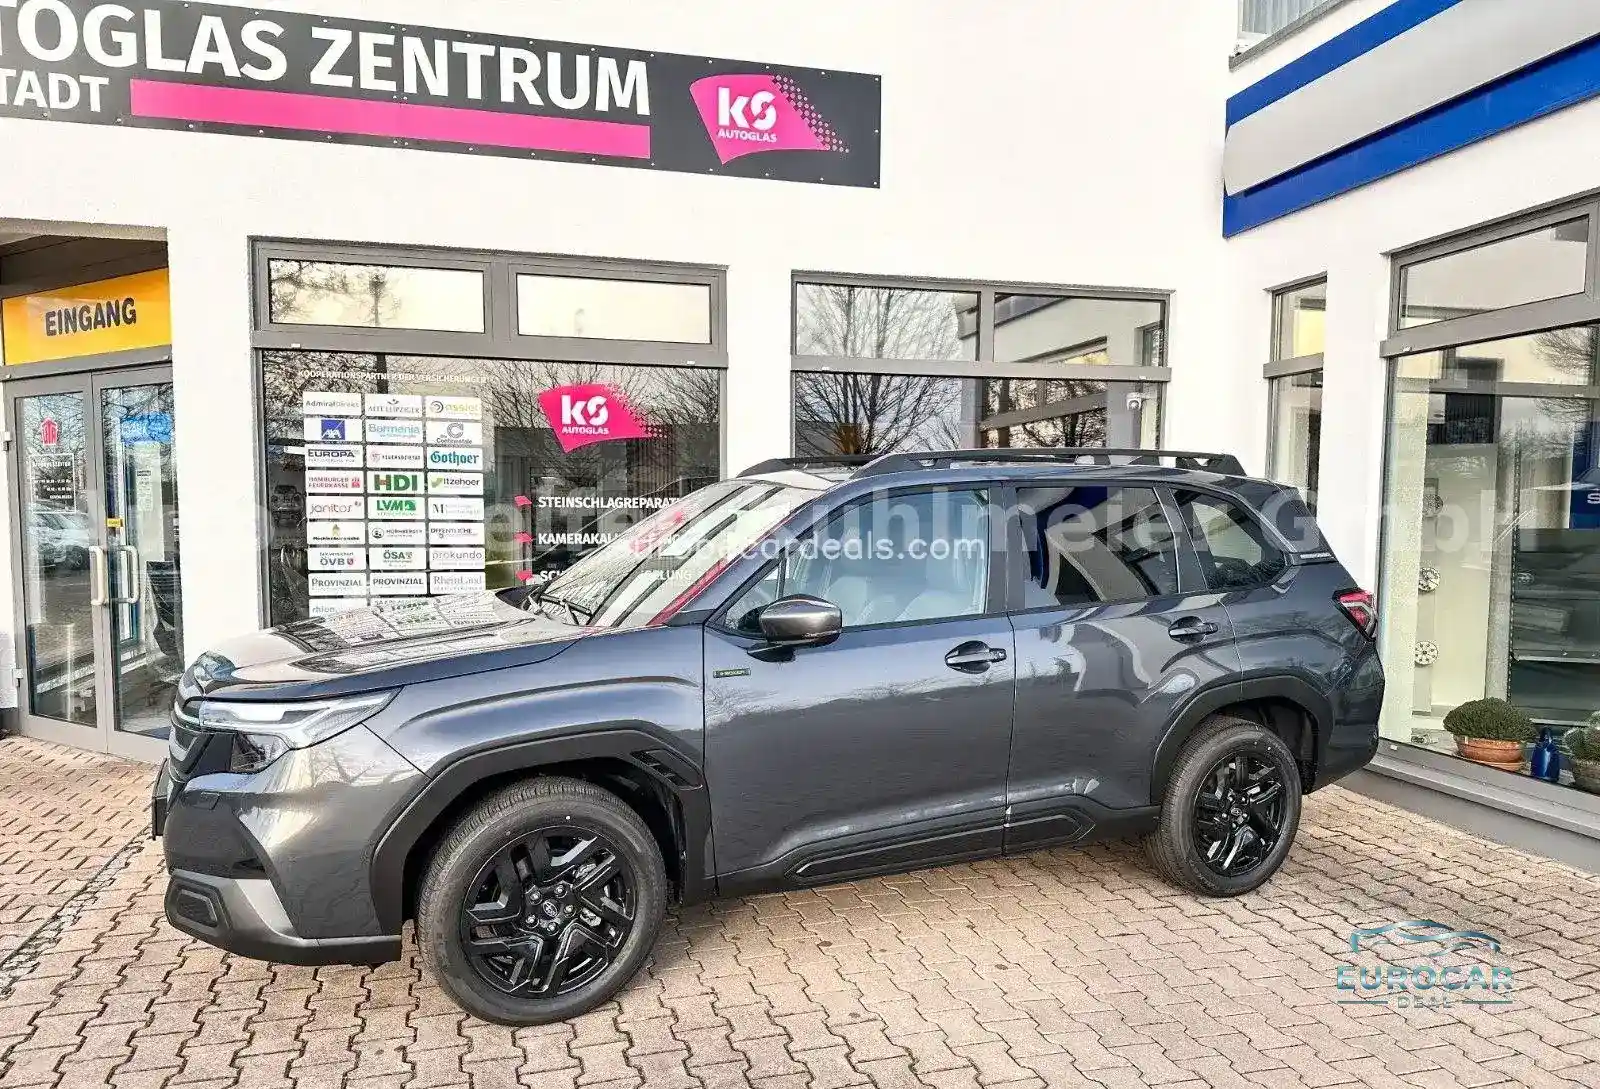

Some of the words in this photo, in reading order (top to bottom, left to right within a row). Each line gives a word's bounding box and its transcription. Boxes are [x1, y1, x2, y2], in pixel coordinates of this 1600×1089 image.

[310, 26, 651, 116] ZENTRUM
[717, 129, 778, 143] AUTOGLAS
[45, 297, 137, 337] EINGANG
[321, 428, 342, 439] AXA
[368, 423, 420, 434] Barmenia
[561, 427, 610, 436] AUTOGLAS
[307, 448, 355, 458] EUROPA
[430, 451, 480, 467] Gothaer
[374, 474, 418, 491] HDI
[443, 478, 480, 486] Itzehoer
[376, 499, 404, 511] LVM
[538, 496, 681, 509] STEINSCHLAGREPARAT
[310, 503, 353, 515] janitos
[383, 550, 405, 559] ÖSA
[432, 551, 483, 561] prokundo
[320, 556, 345, 566] ÖVB
[311, 577, 363, 587] PROVINZIAL
[372, 578, 424, 586] PROVINZIAL
